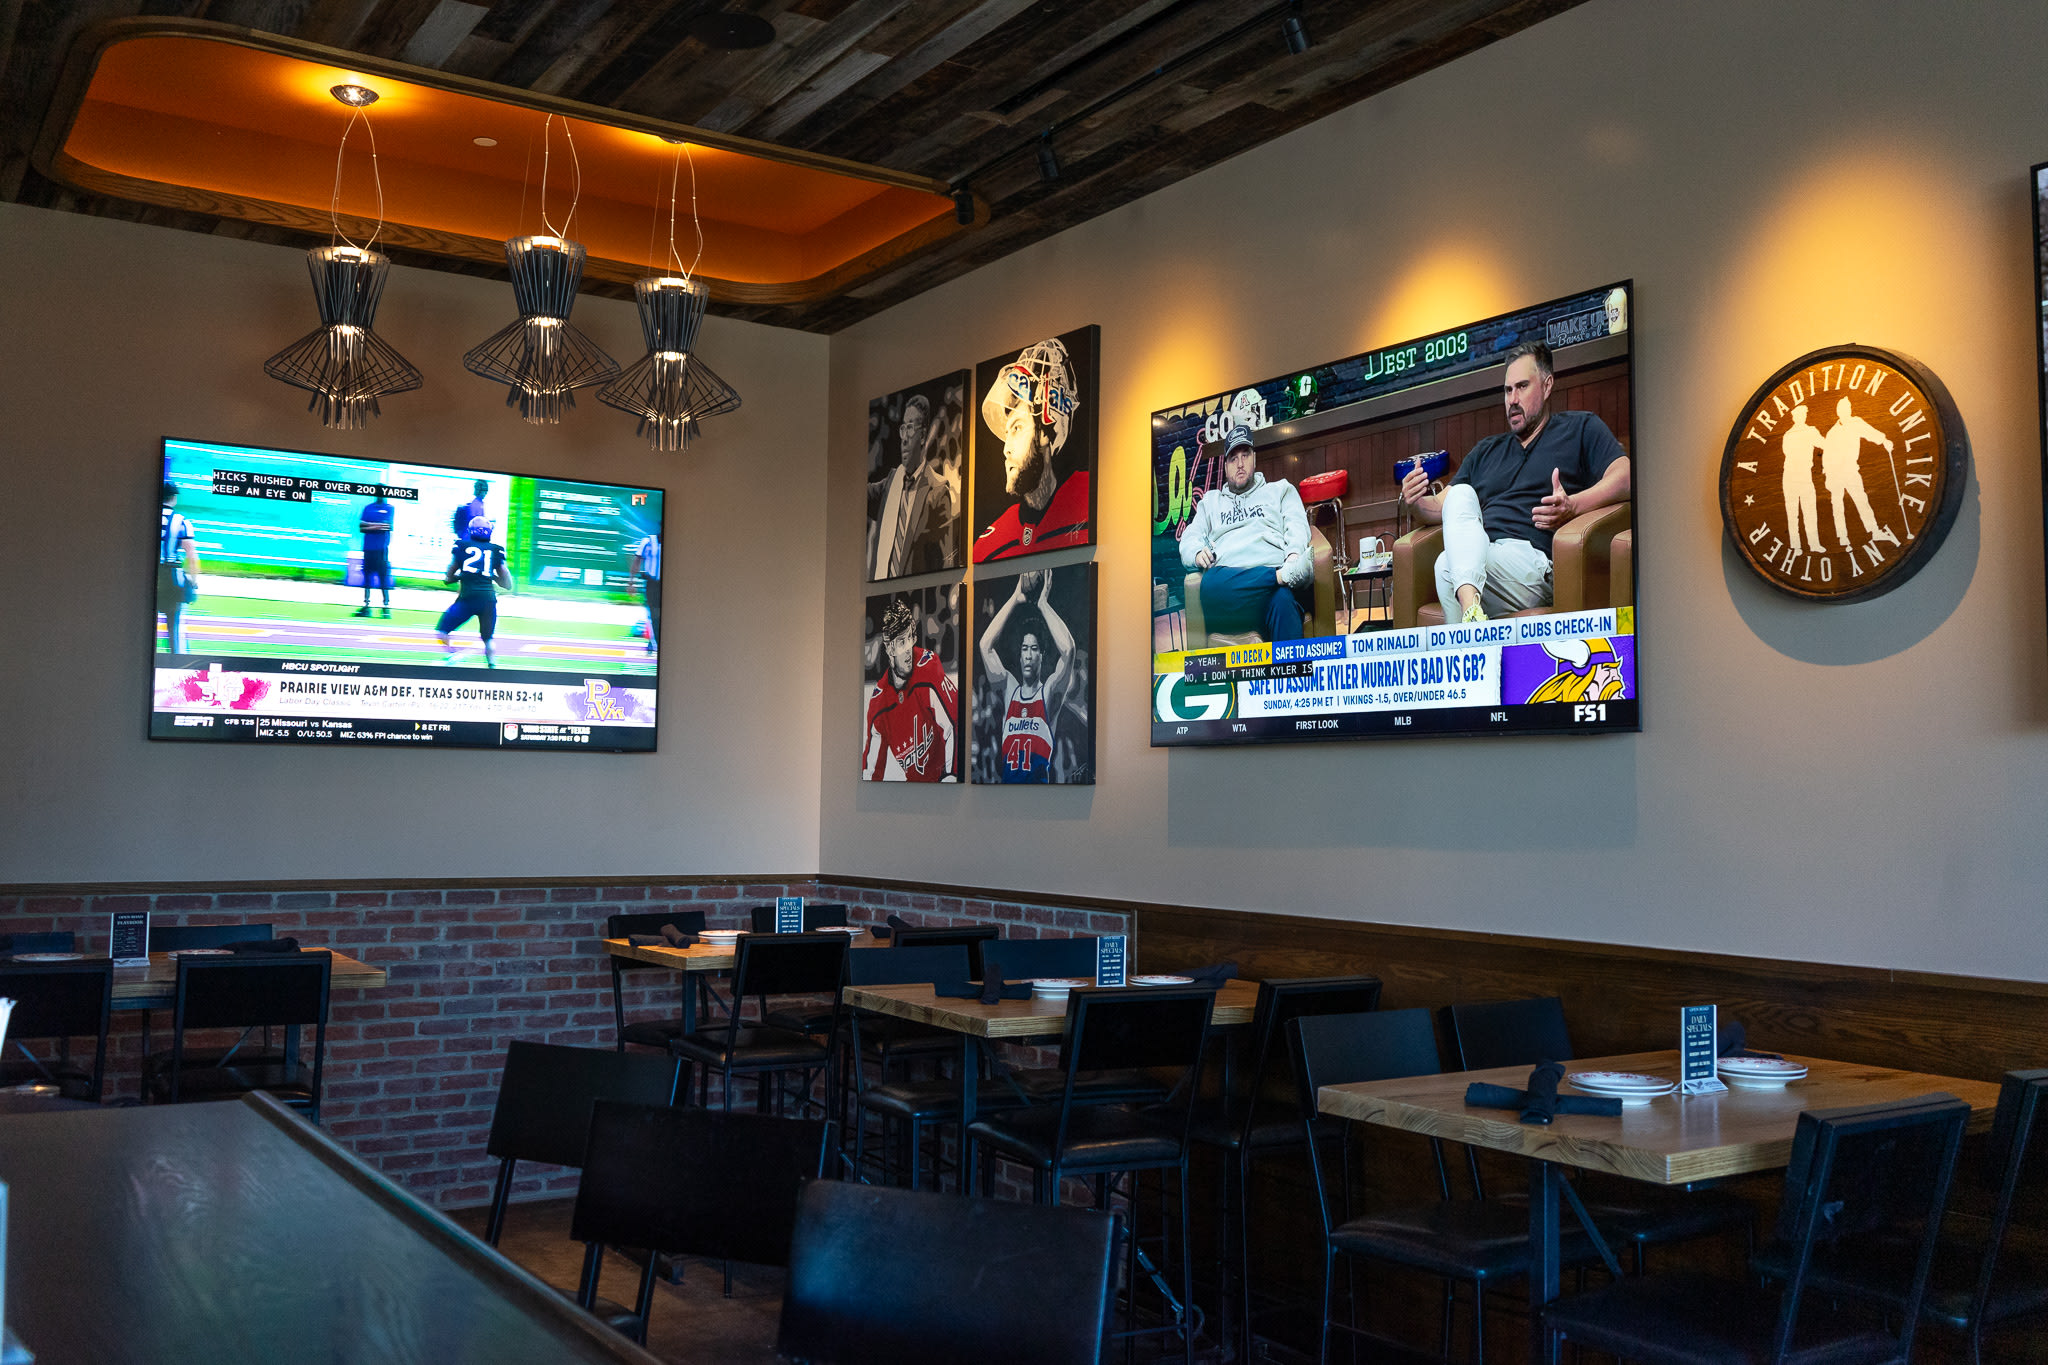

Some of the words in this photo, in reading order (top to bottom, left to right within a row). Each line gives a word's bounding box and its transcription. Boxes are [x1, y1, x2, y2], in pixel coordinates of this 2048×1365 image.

[1425, 332, 1467, 363] 2003
[1747, 364, 1888, 445] TRADITION
[1889, 391, 1933, 513] UNLIKE
[1737, 461, 1758, 473] A
[213, 471, 247, 482] HICKS
[253, 475, 293, 487] RUSHED
[299, 479, 319, 489] FOR
[324, 482, 350, 492] OVER
[356, 485, 376, 494] 200
[381, 487, 418, 499] YARDS.
[213, 483, 240, 494] KEEP
[246, 487, 260, 496] AN
[266, 489, 286, 499] EYE
[292, 491, 306, 500] ON
[1749, 522, 1833, 582] OTHER
[1850, 524, 1901, 578] ANY
[462, 546, 493, 577] 21
[1431, 631, 1445, 646] DO
[1449, 629, 1471, 644] YOU
[1475, 626, 1512, 643] CARE?
[1521, 621, 1551, 639] CUBS
[1554, 616, 1612, 635] CHECK-IN
[1275, 646, 1294, 661] SAFE
[1295, 645, 1305, 659] TO
[1306, 641, 1343, 658] ASSUME?
[1352, 638, 1374, 653] TOM
[1377, 634, 1419, 651] RINALDI
[1198, 657, 1221, 667] YEAH.
[1231, 651, 1241, 665] ON
[1243, 649, 1263, 664] DECK
[310, 663, 360, 674] SPOTLIGHT
[1184, 673, 1197, 683] NO,
[1212, 670, 1236, 680] DON'T
[1241, 667, 1266, 678] THINK
[1270, 665, 1297, 676] KYLER
[1302, 663, 1313, 673] IS
[1327, 663, 1358, 690] KYLER
[1361, 660, 1405, 688] MURRAY
[1408, 658, 1419, 685] IS
[1421, 656, 1443, 684] BAD
[1446, 655, 1460, 682] VS
[1463, 653, 1486, 682] GB?
[280, 681, 327, 695] PRAIRIE
[330, 683, 361, 696] VIEW
[363, 685, 388, 697] A&M
[391, 686, 415, 699] DEF.
[419, 687, 453, 699] TEXAS
[456, 688, 513, 701] SOUTHERN
[516, 691, 544, 702] 52-14
[1263, 699, 1293, 710] SUNDAY,
[1295, 698, 1310, 707] 4:25
[1313, 697, 1323, 707] PM
[1325, 696, 1333, 706] ET
[1343, 694, 1373, 706] VIKINGS
[1375, 692, 1391, 704] -1.5,
[1393, 690, 1445, 702] OVER/UNDER
[1448, 688, 1466, 700] 46.5
[174, 715, 214, 726] ESPN
[259, 718, 270, 727] 25
[271, 719, 308, 728] Missouri
[322, 720, 353, 729] Kansas
[438, 724, 450, 732] FRI
[1008, 719, 1040, 732] bullets
[1176, 726, 1188, 735] ATP
[1232, 724, 1247, 732] WTA
[1296, 720, 1317, 730] FIRST
[1318, 719, 1338, 729] LOOK
[1394, 716, 1412, 726] MLB
[1490, 712, 1508, 722] NFL
[1574, 704, 1606, 722] FS1
[259, 729, 274, 737] MIZ
[316, 730, 333, 738] 50.5
[1007, 738, 1032, 772] 41
[1686, 1023, 1712, 1033] SPECIALS
[1691, 1014, 1707, 1025] DAILY
